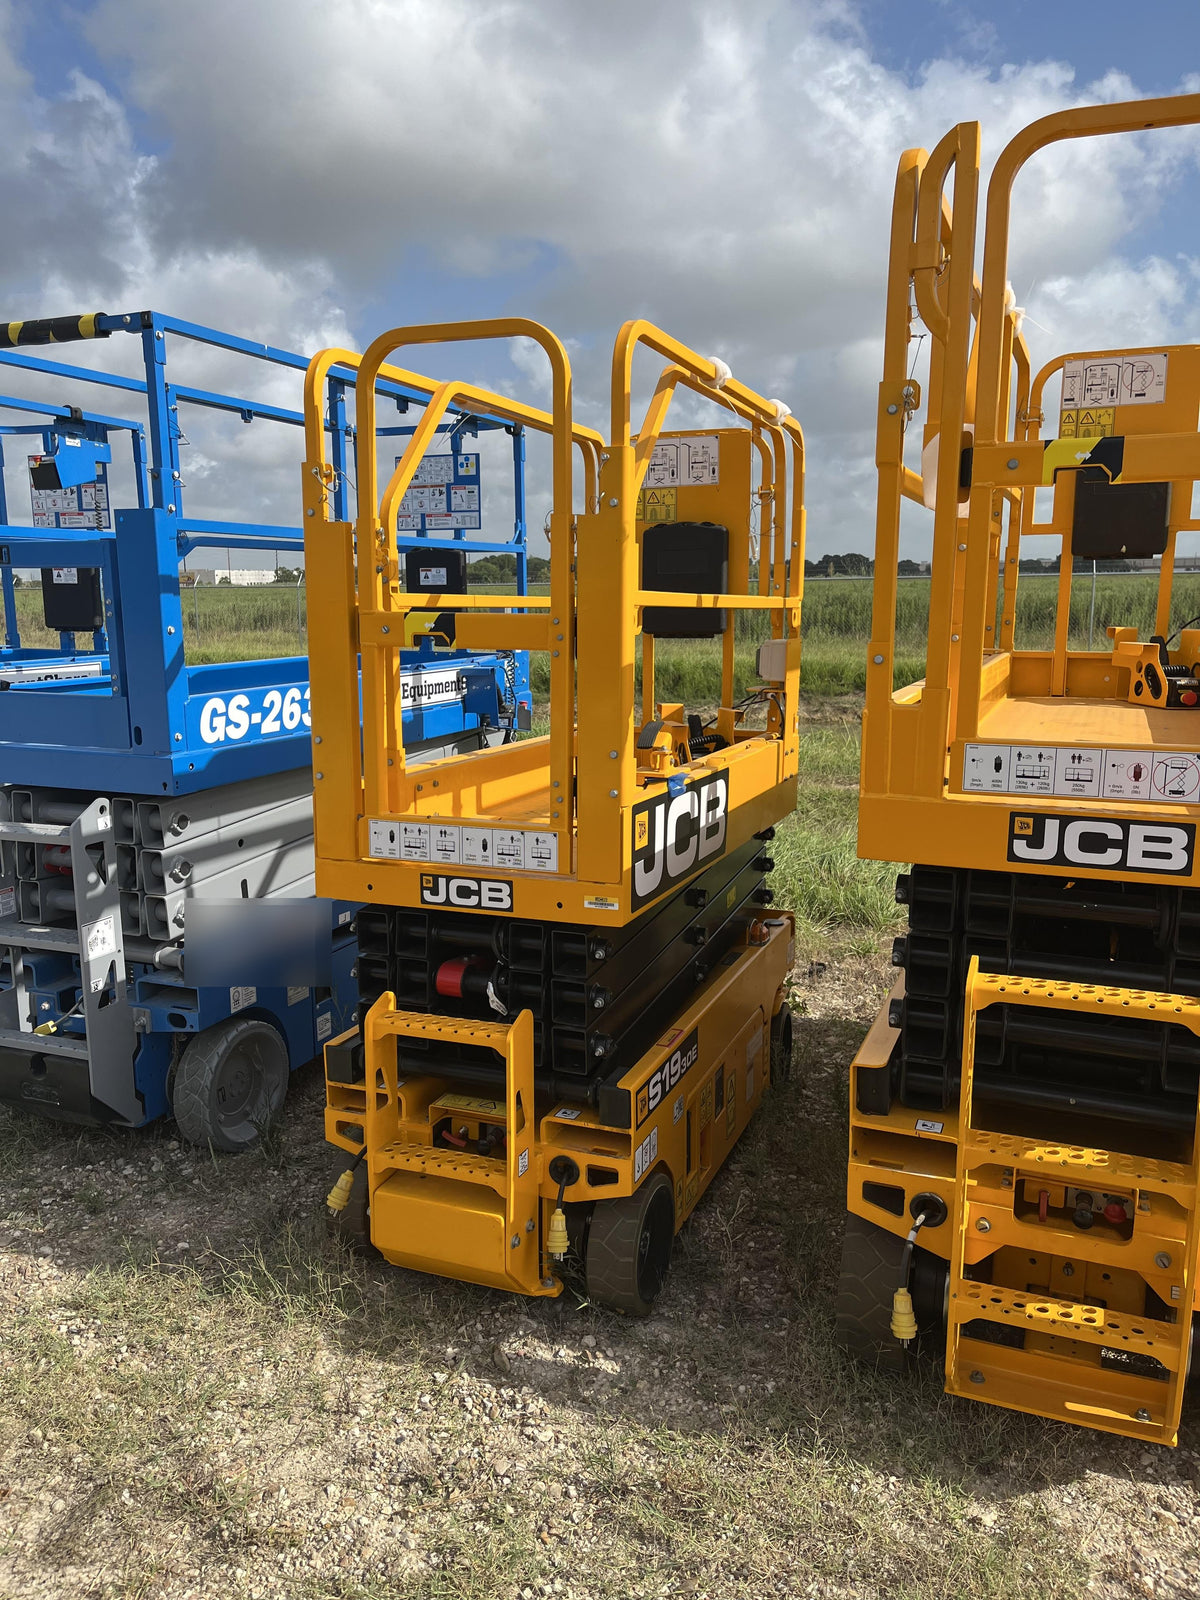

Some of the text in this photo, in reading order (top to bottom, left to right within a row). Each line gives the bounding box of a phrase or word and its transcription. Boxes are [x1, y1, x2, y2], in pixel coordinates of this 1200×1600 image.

[635, 779, 727, 897] JCB
[1013, 818, 1189, 871] JCB
[422, 877, 511, 909] JCB
